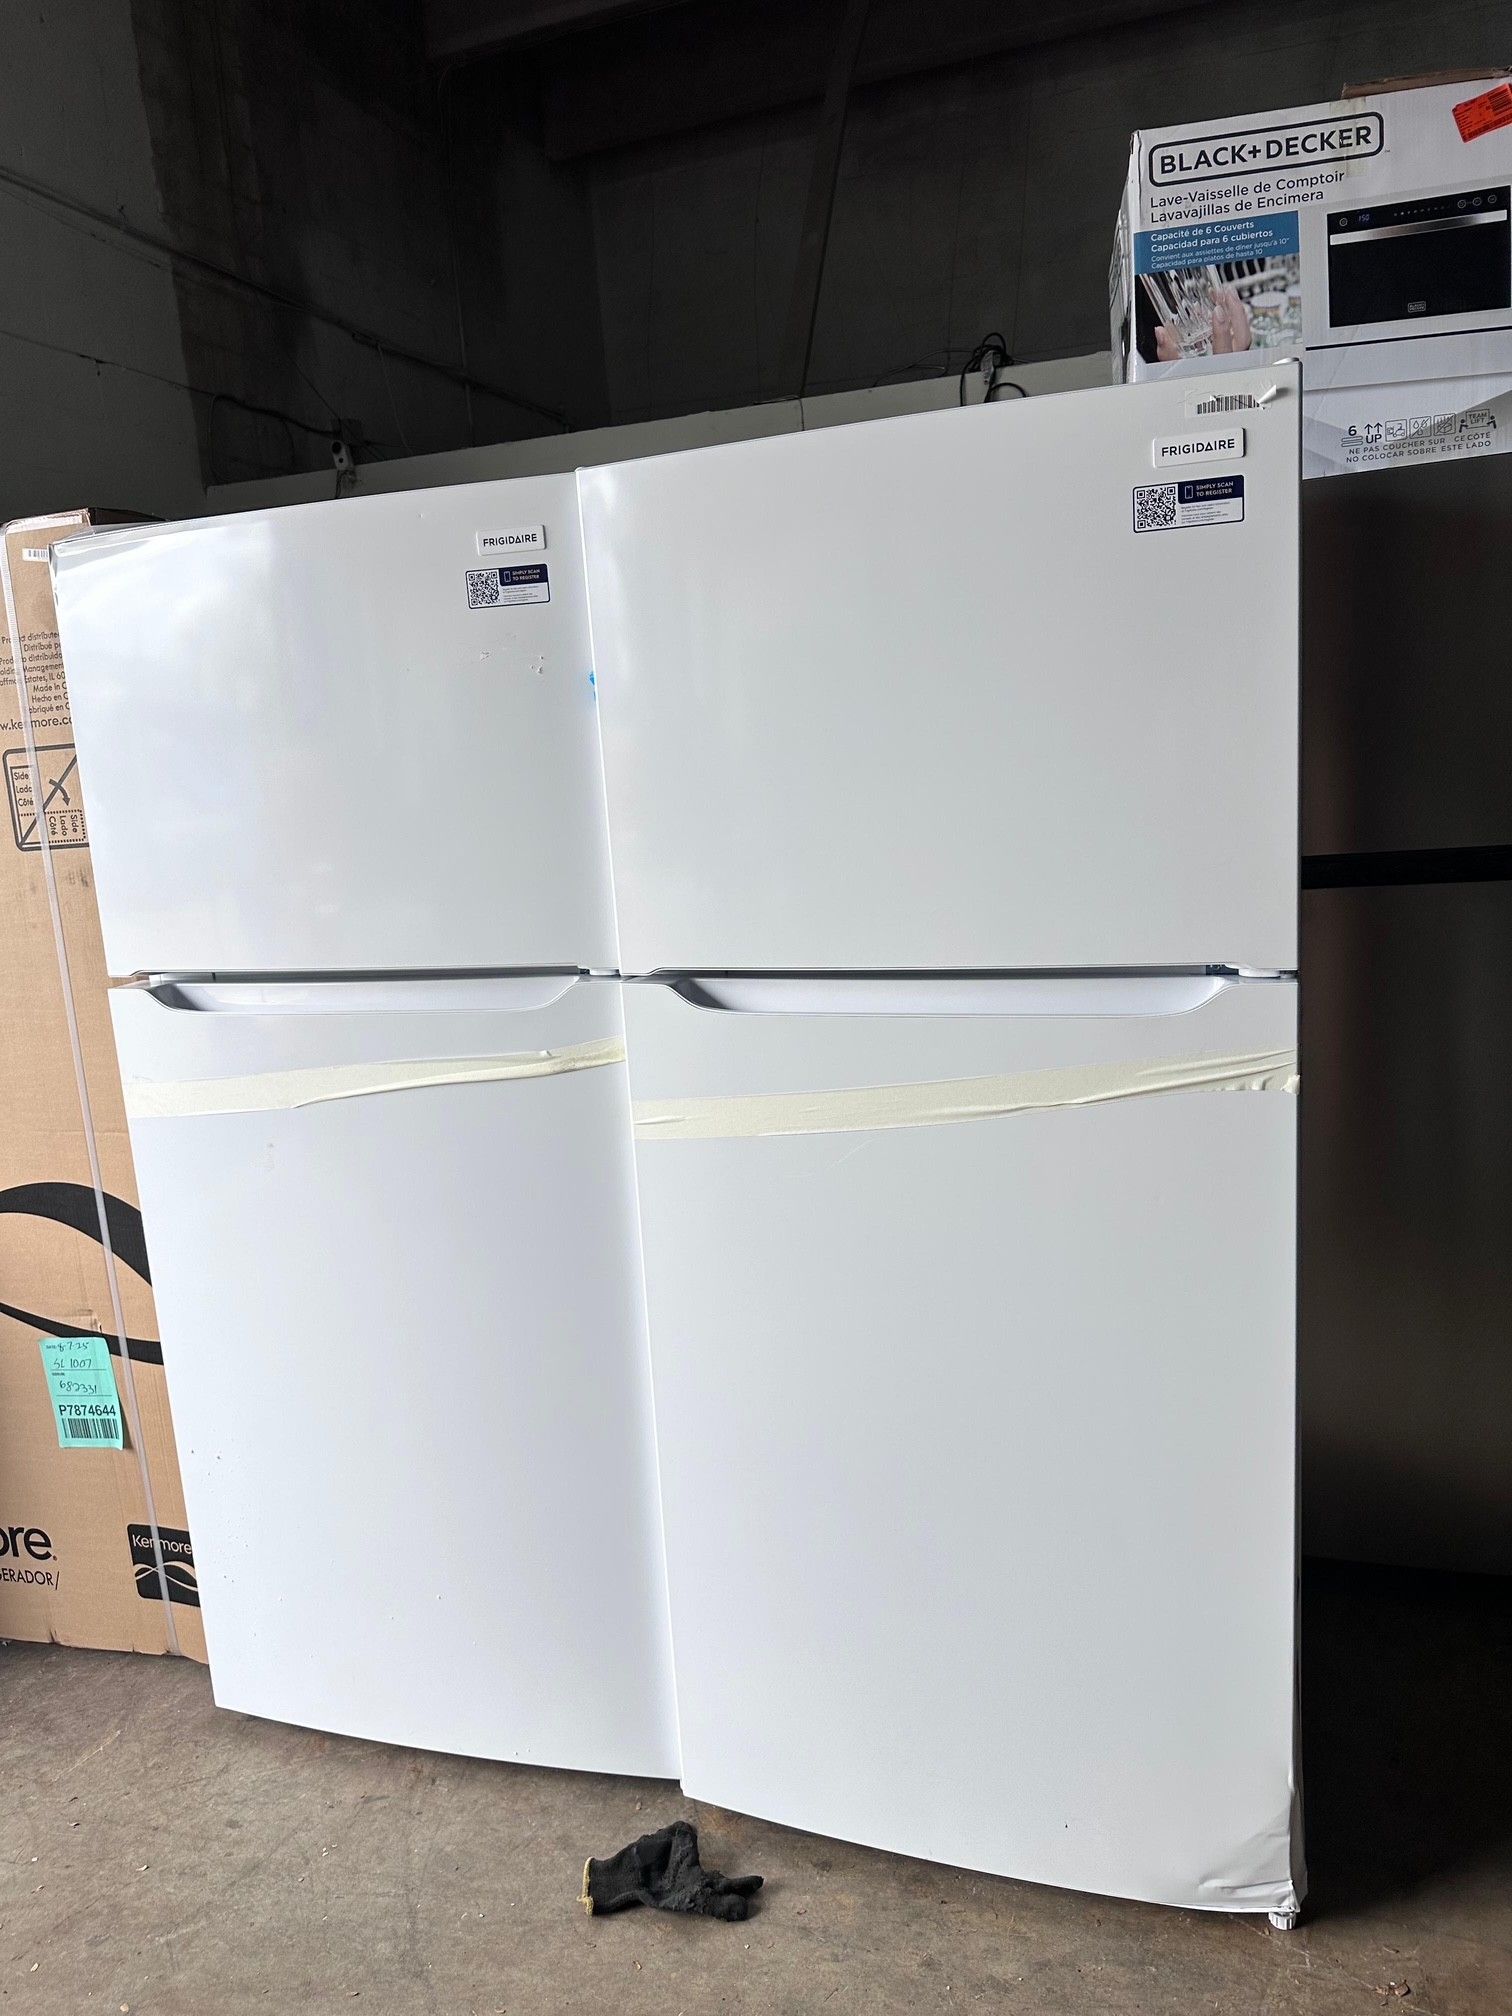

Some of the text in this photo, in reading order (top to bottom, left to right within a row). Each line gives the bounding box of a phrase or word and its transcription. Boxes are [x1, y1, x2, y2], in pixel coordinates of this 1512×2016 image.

[1160, 125, 1372, 175] BLACK+DECKER
[1151, 171, 1345, 208] Lave-Vaisselle de Comptoir
[1151, 191, 1324, 223] Lavavajillas de Encimera
[1151, 221, 1255, 242] Capacité de 6 Couverts
[1151, 229, 1273, 253] Capacidad para 6 cubiertos
[1151, 253, 1181, 262] Convient
[1195, 246, 1224, 257] assiettes
[1151, 259, 1186, 269] Capacidad
[1187, 256, 1203, 265] para
[1348, 425, 1357, 437] 6
[1365, 433, 1382, 444] UP
[1161, 438, 1235, 457] FRIGIDAIRE
[1349, 447, 1361, 455] NE
[1363, 445, 1380, 453] PAS
[1382, 440, 1425, 451] COUCHER
[1428, 438, 1445, 446] SUR
[1361, 450, 1404, 461] COLOCAR
[1407, 446, 1437, 456] SOBRE
[1441, 443, 1463, 452] ESTE
[1466, 440, 1491, 449] LADO
[483, 533, 537, 547] FRIGIDAIRE
[33, 685, 53, 693] Made
[54, 683, 61, 691] in
[31, 694, 53, 703] Hecho
[13, 771, 29, 781] Side
[59, 815, 68, 837] Lado
[70, 814, 78, 833] Side
[70, 1358, 92, 1369] 1007
[58, 1404, 116, 1416] P7874644
[0, 1567, 60, 1591] ERADOR/
